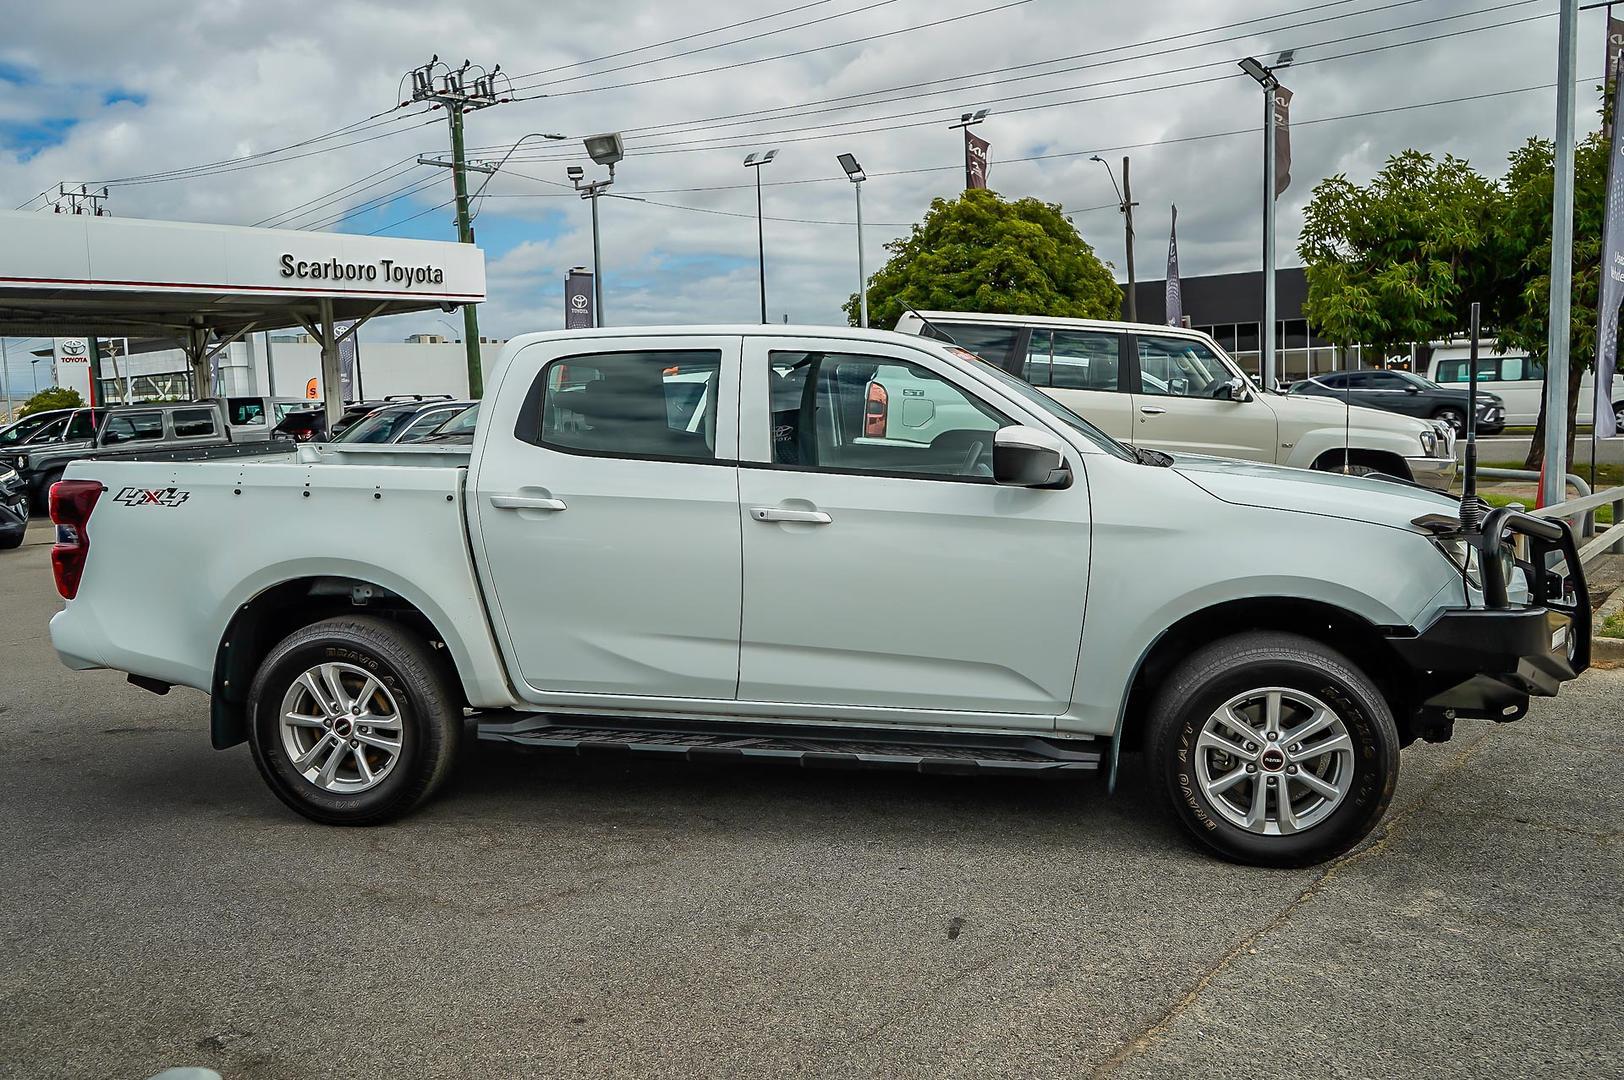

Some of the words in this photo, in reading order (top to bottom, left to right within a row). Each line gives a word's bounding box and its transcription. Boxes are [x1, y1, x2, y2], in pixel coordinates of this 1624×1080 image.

[280, 253, 377, 281] Scarboro
[380, 259, 443, 288] Toyota
[1178, 773, 1217, 831] BRAVO
